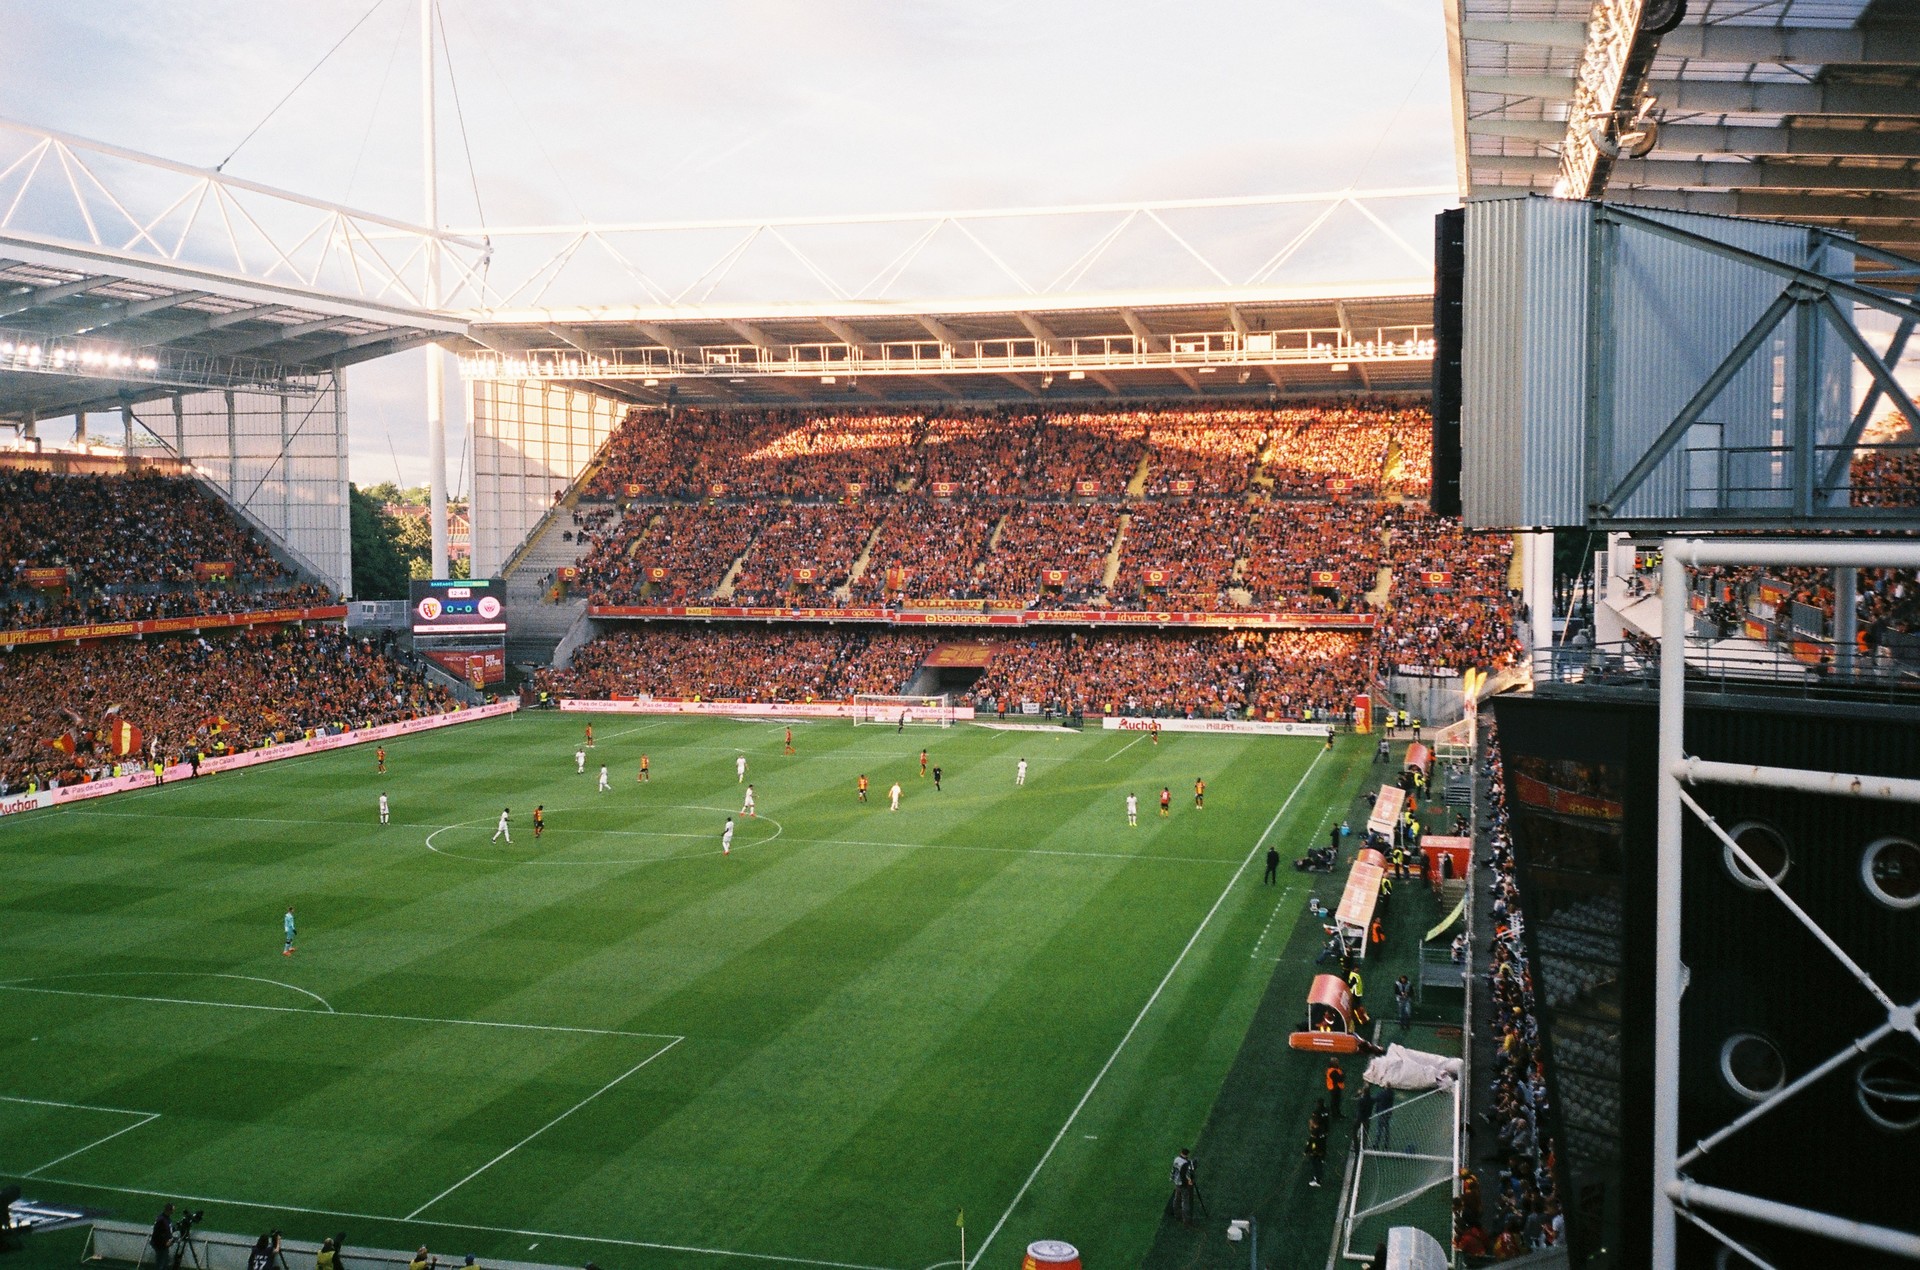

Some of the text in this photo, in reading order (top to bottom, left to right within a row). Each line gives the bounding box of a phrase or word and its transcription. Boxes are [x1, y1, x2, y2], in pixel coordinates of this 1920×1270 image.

[904, 600, 981, 608] OLLAERT
[937, 614, 992, 623] boulanger
[64, 624, 133, 637] GROUPE LEMPEREUR
[94, 781, 114, 790] Calais
